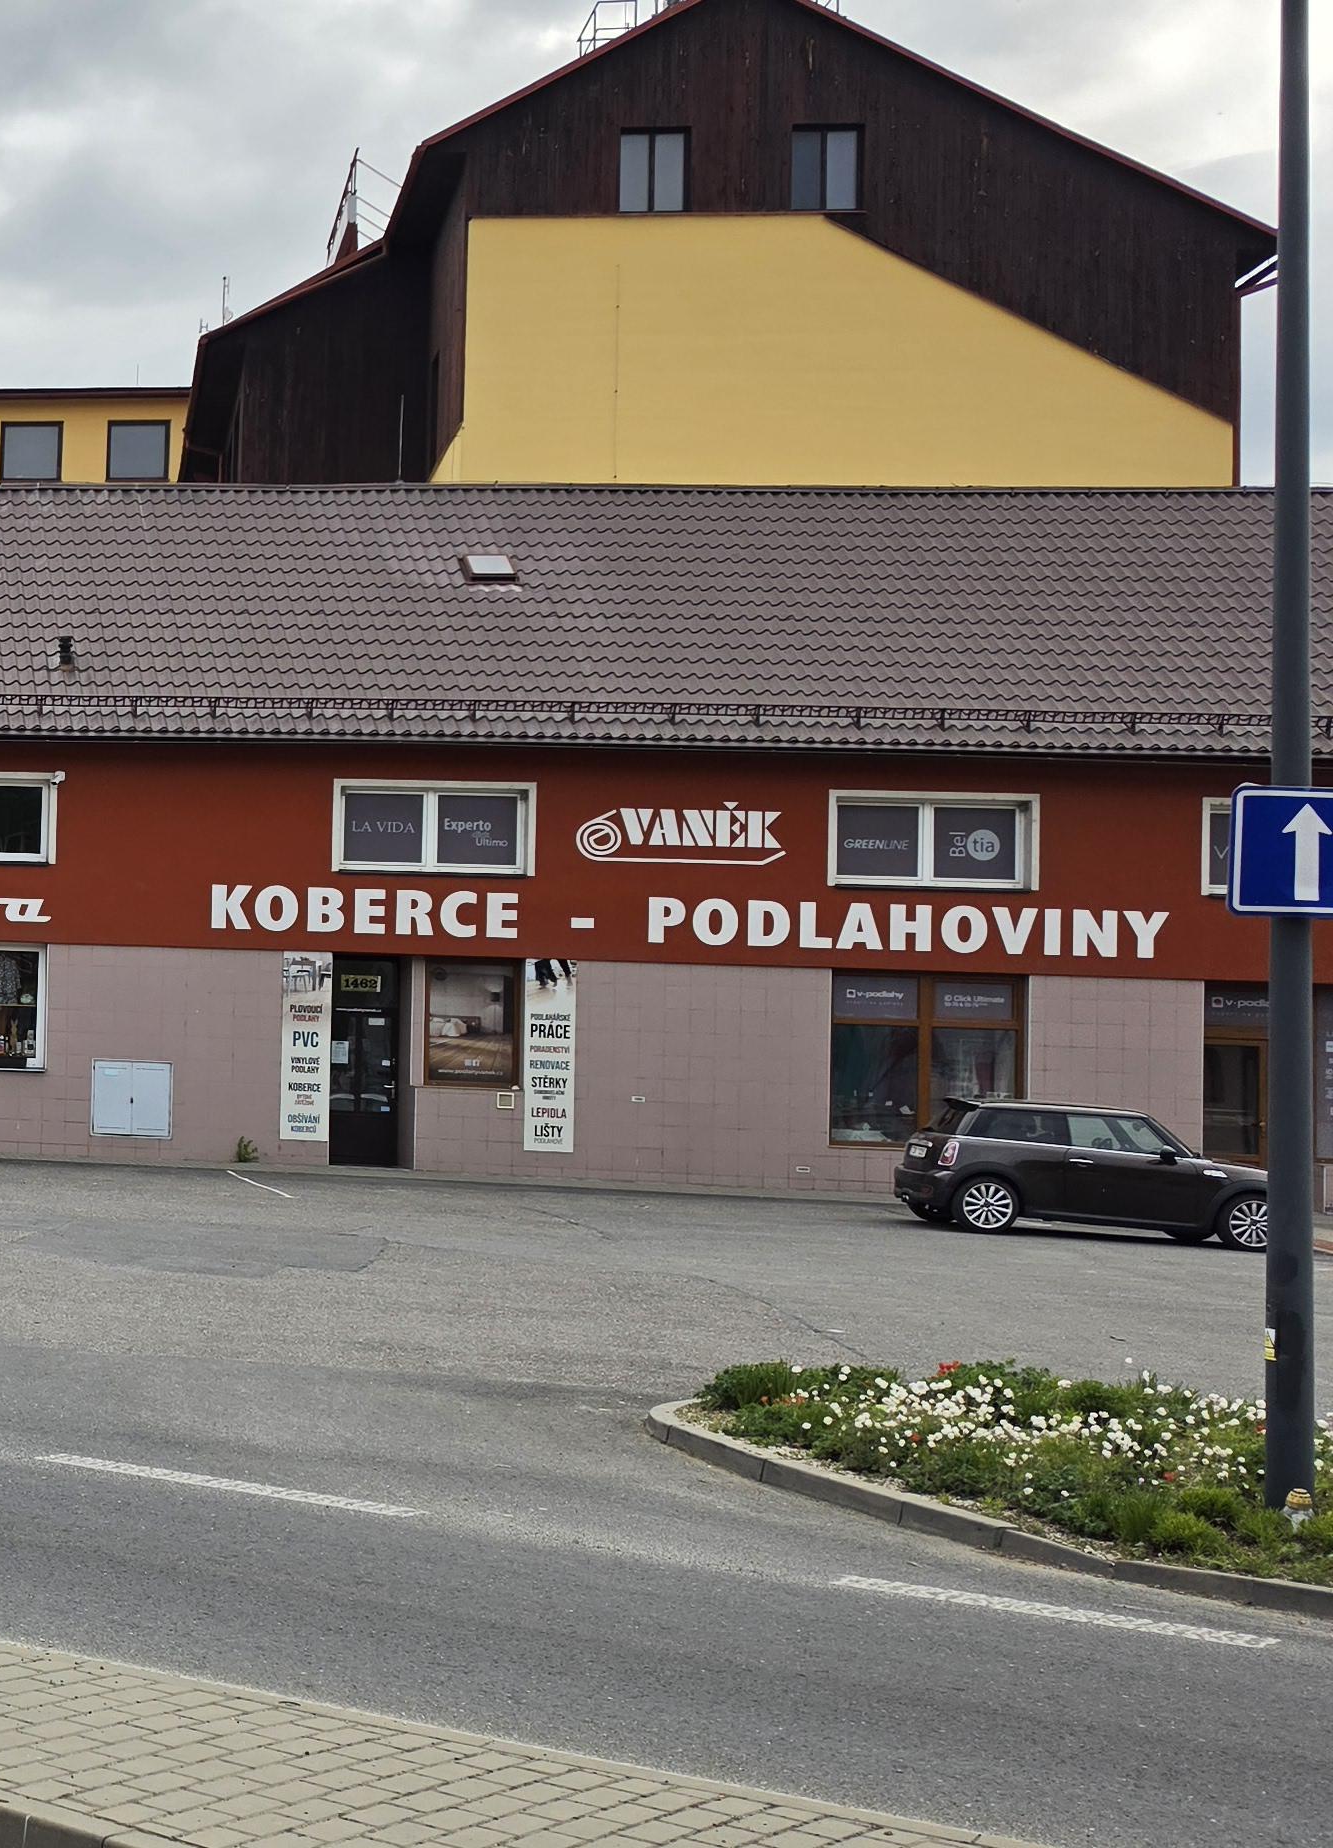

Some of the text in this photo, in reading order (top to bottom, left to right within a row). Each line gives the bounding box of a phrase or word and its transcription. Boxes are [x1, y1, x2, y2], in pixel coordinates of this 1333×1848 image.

[352, 820, 416, 834] LA VIDA
[444, 818, 492, 834] Experto
[620, 801, 782, 849] VANĚK
[844, 838, 910, 850] GREENLINE
[973, 837, 995, 853] tia
[211, 884, 520, 939] KOBERCE
[647, 897, 1170, 959] PODLAHOVINY
[344, 978, 378, 988] 1462
[290, 1004, 323, 1014] PLOVOUCÍ
[530, 1021, 571, 1040] PRÁCE
[293, 1030, 319, 1047] PVC
[291, 1056, 320, 1065] VINYLOVÉ
[530, 1060, 571, 1071] RENOVACE
[291, 1065, 320, 1074] PODLAHY
[288, 1082, 321, 1092] KOBERCE
[531, 1075, 568, 1089] STĚRKY
[531, 1106, 567, 1119] LEPIDLA
[534, 1122, 564, 1138] LIŠTY
